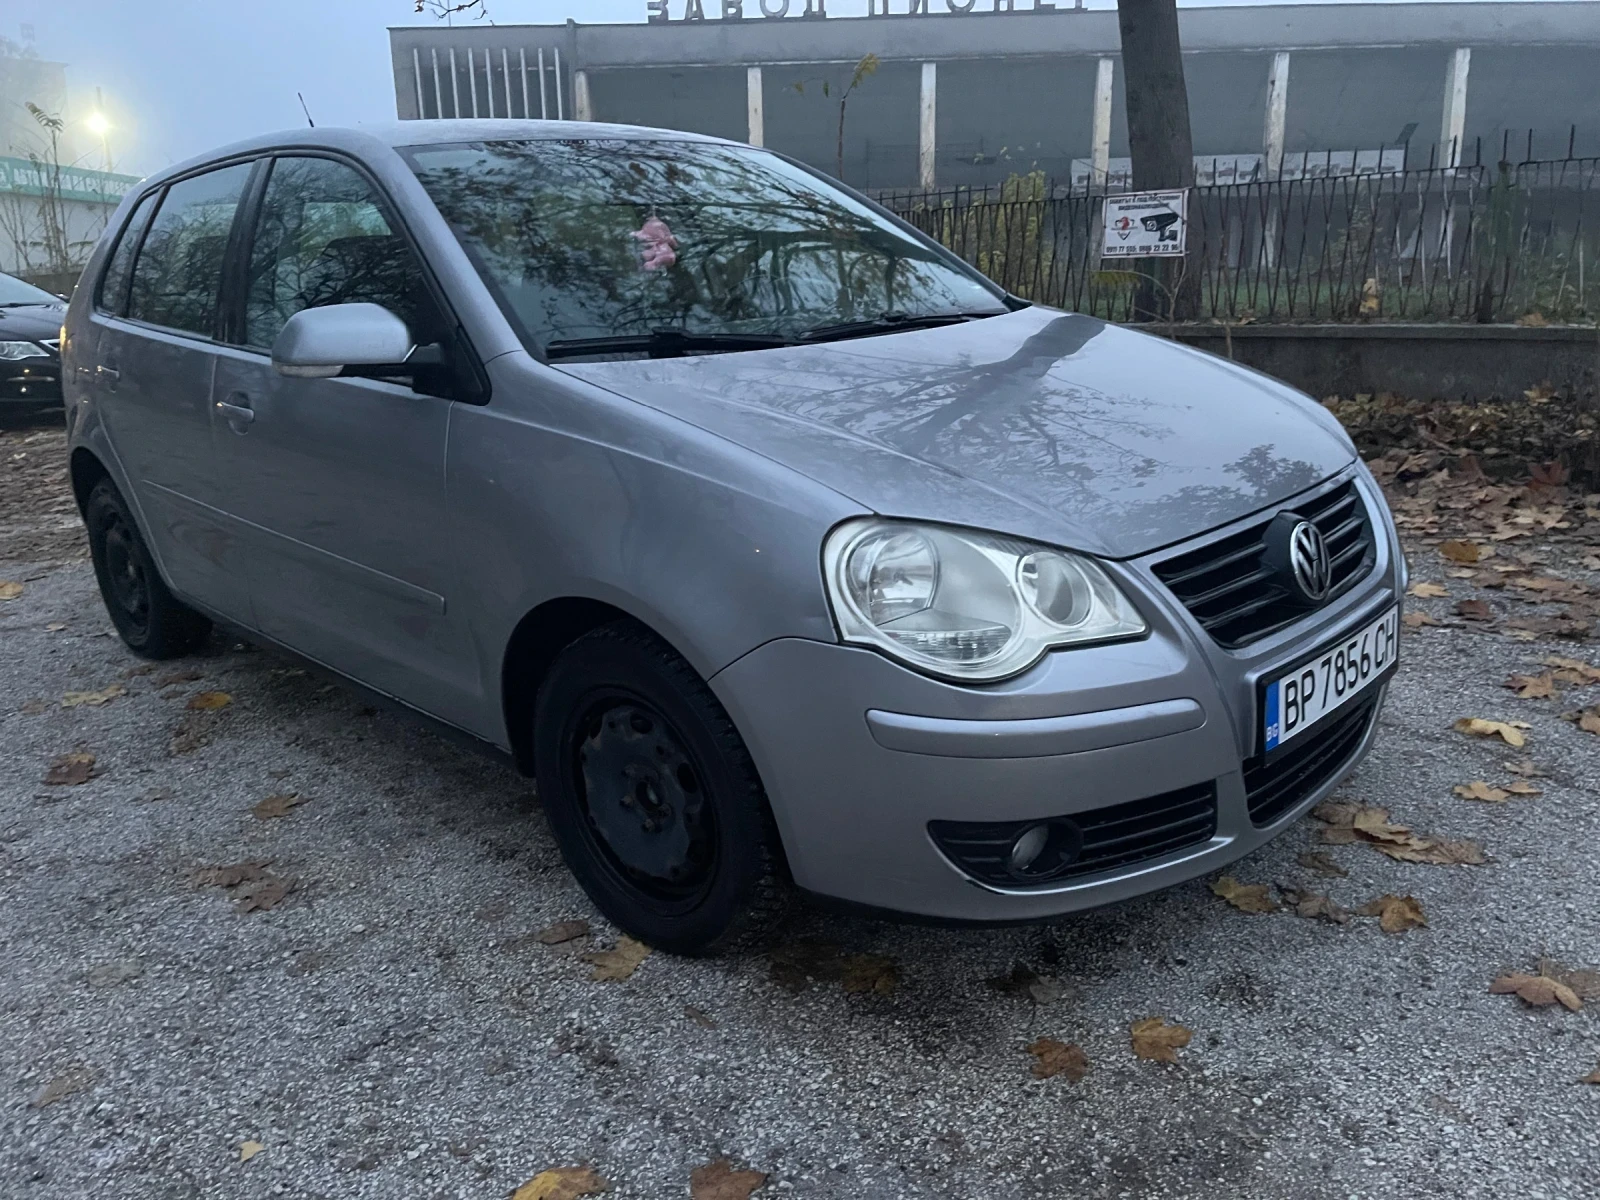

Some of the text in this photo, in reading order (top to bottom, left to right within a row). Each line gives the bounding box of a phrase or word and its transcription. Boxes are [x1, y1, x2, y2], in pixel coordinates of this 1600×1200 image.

[647, 0, 827, 20] ЗАВОД
[1284, 613, 1396, 734] BP 7856 CH
[1266, 723, 1279, 742] BG
